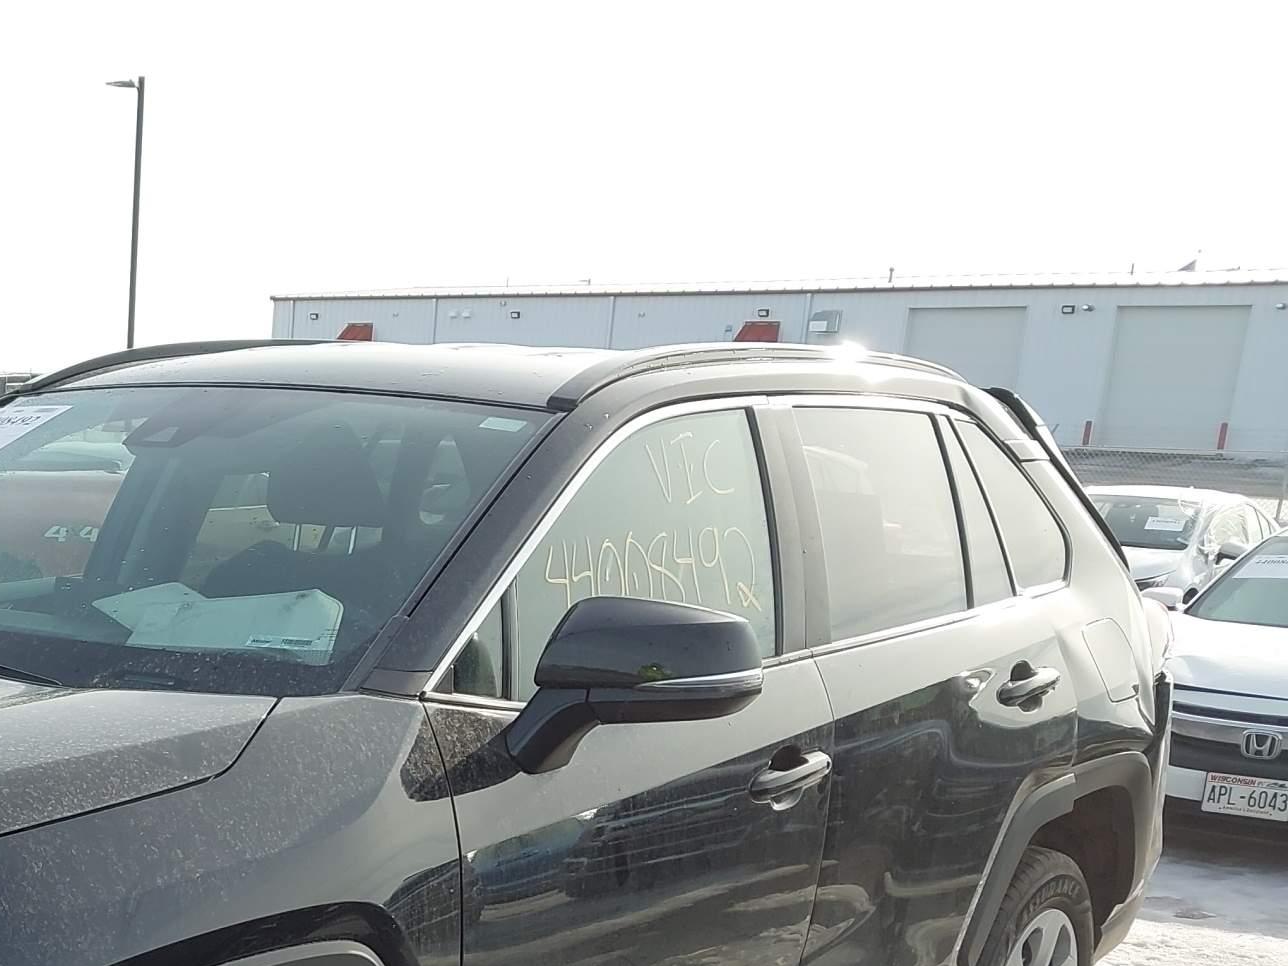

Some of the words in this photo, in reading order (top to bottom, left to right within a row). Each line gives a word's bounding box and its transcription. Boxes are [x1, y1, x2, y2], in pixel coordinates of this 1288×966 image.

[645, 431, 735, 504] VIC
[44, 525, 100, 542] 44
[1210, 774, 1257, 786] WISCONSIN
[1207, 784, 1288, 812] APL-6043
